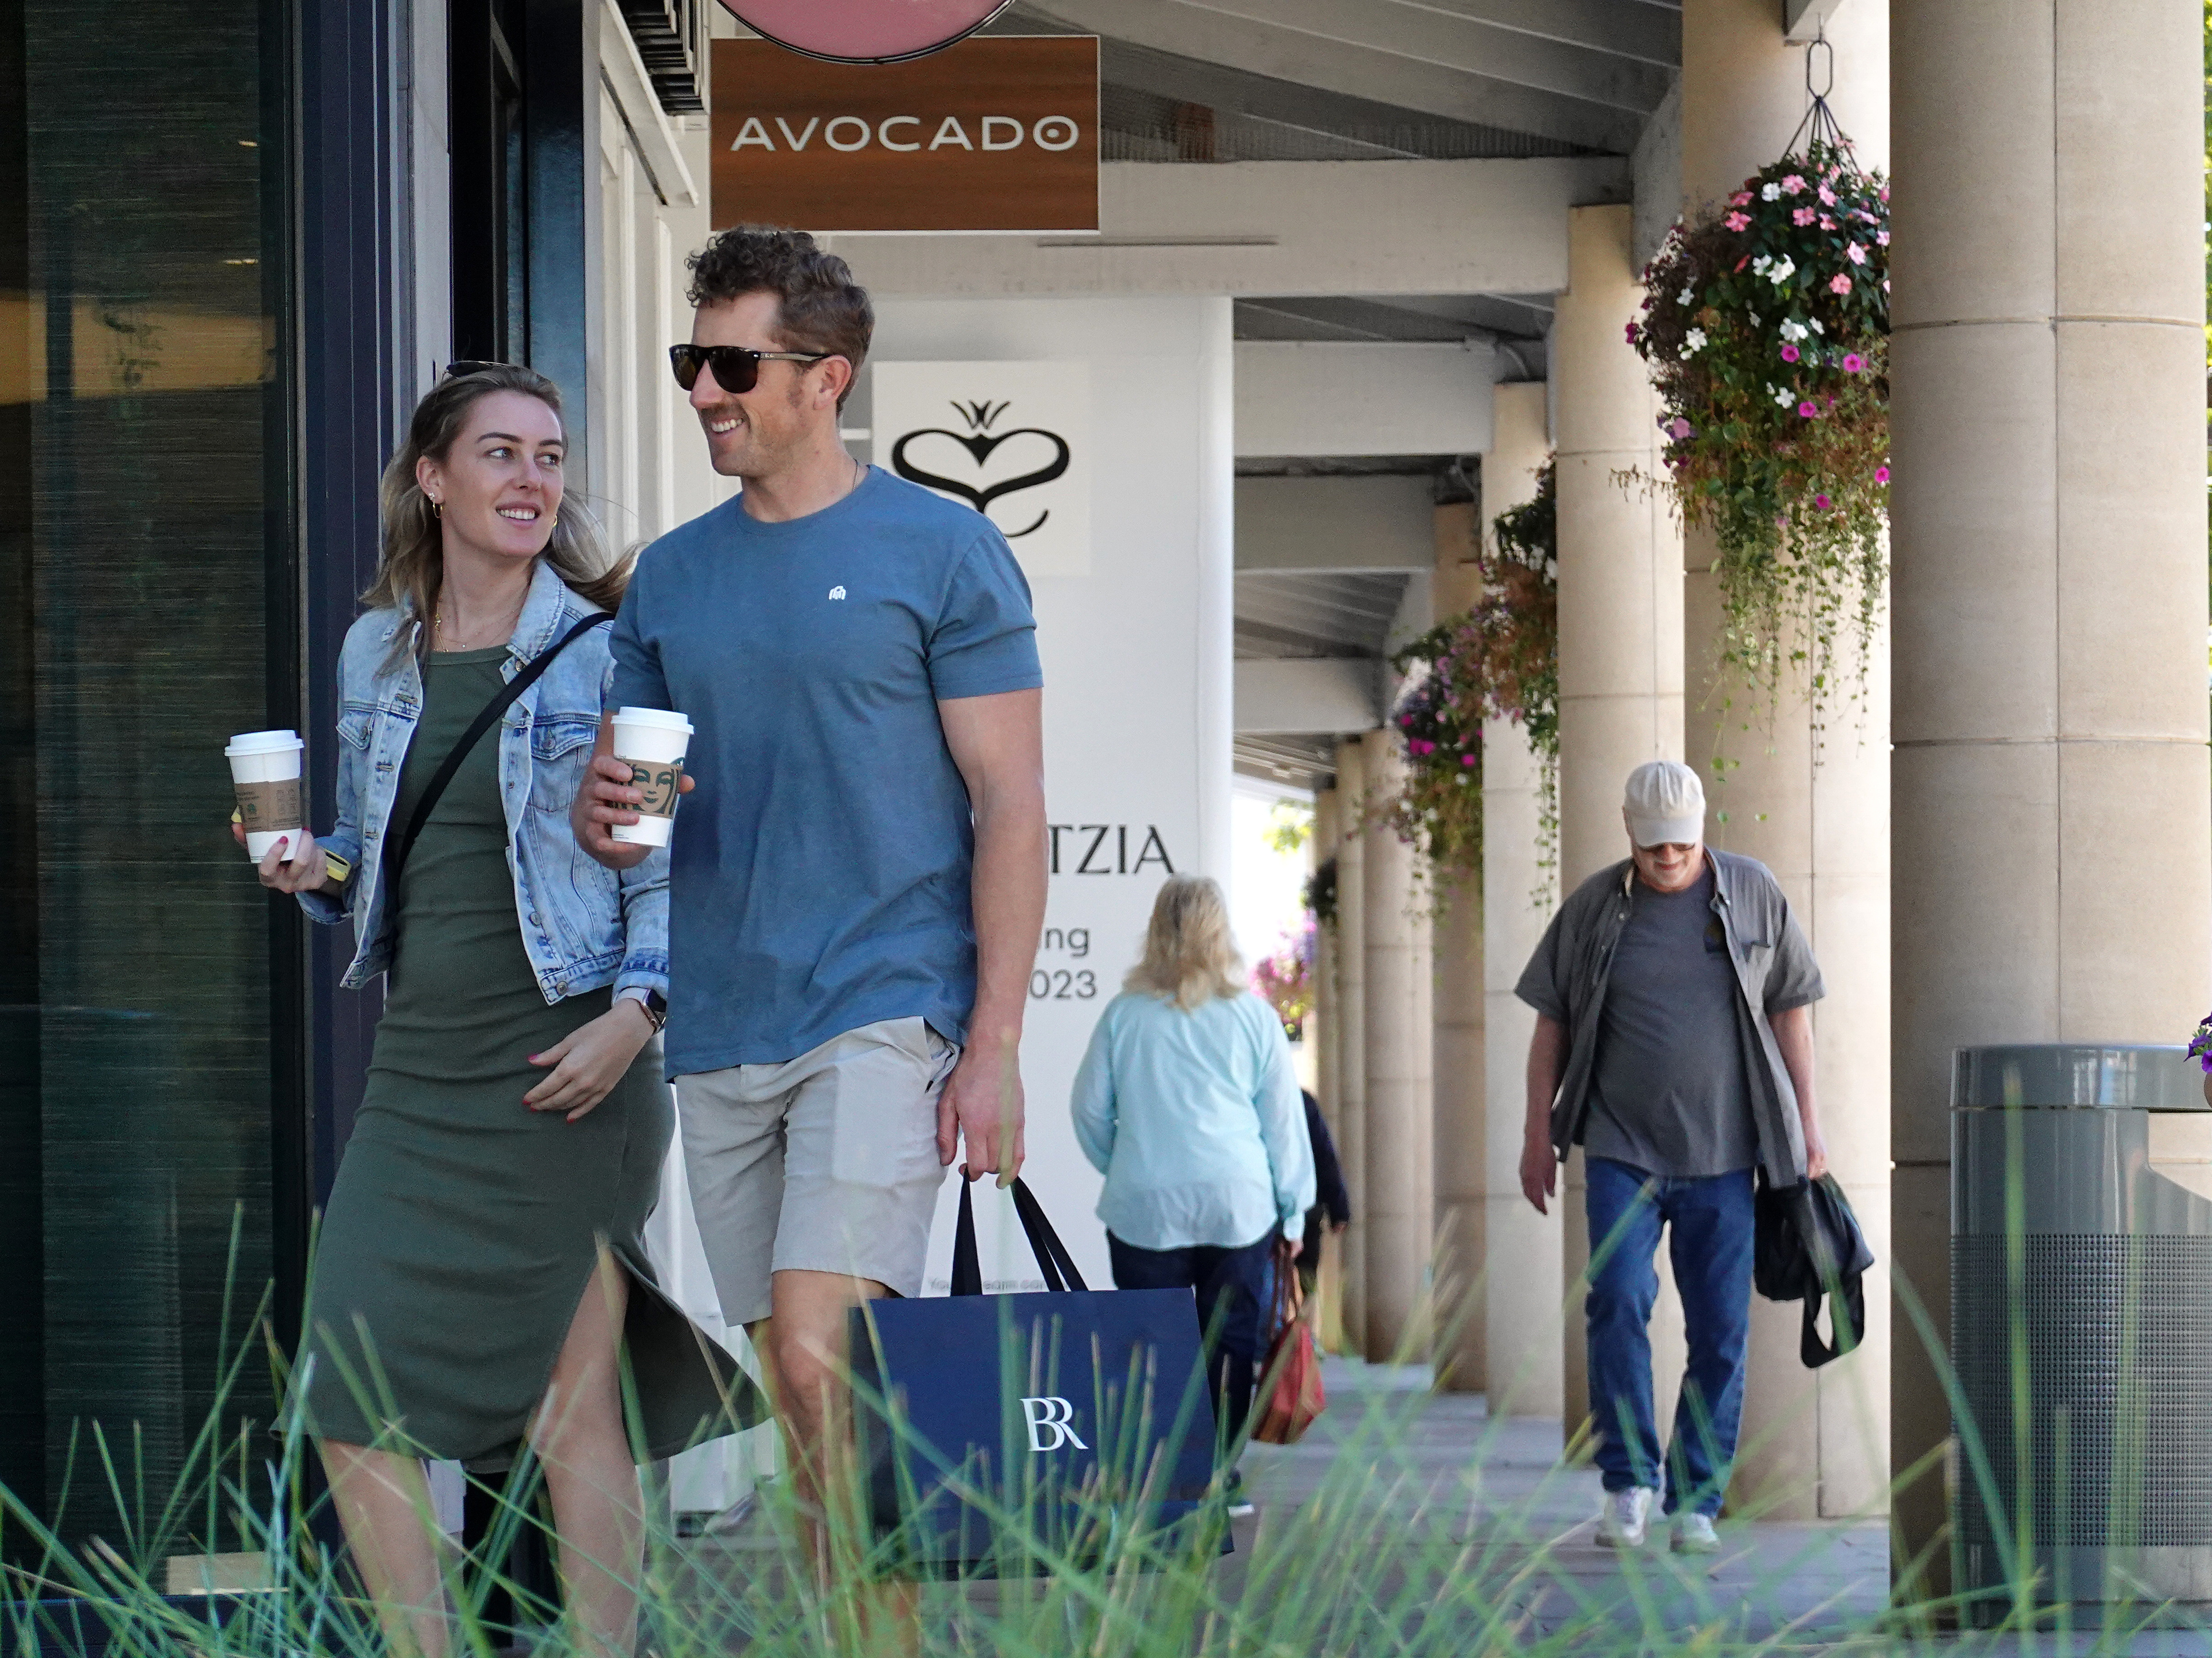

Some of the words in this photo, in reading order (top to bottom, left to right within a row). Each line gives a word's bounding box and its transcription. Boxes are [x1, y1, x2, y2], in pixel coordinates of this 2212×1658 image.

[730, 115, 1079, 151] AVOCADO
[1047, 824, 1175, 874] TZIA
[1029, 969, 1097, 999] 023
[1020, 1397, 1089, 1452] BR
